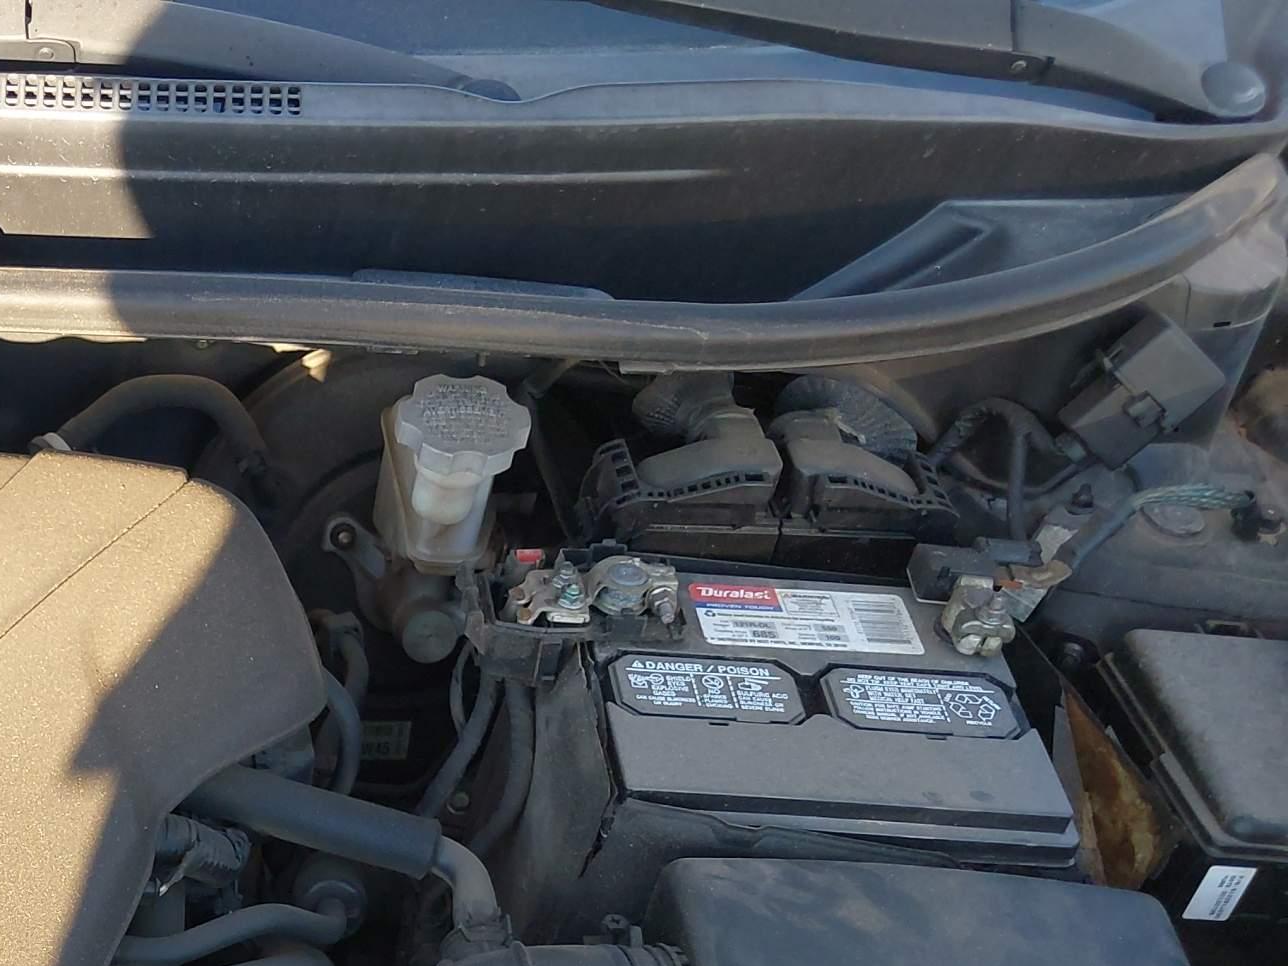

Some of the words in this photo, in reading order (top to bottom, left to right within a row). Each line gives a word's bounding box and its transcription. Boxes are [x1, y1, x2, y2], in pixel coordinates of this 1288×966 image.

[696, 586, 771, 600] Duralast
[752, 630, 777, 638] 685
[645, 661, 703, 672] DANGER
[717, 665, 770, 676] POISON
